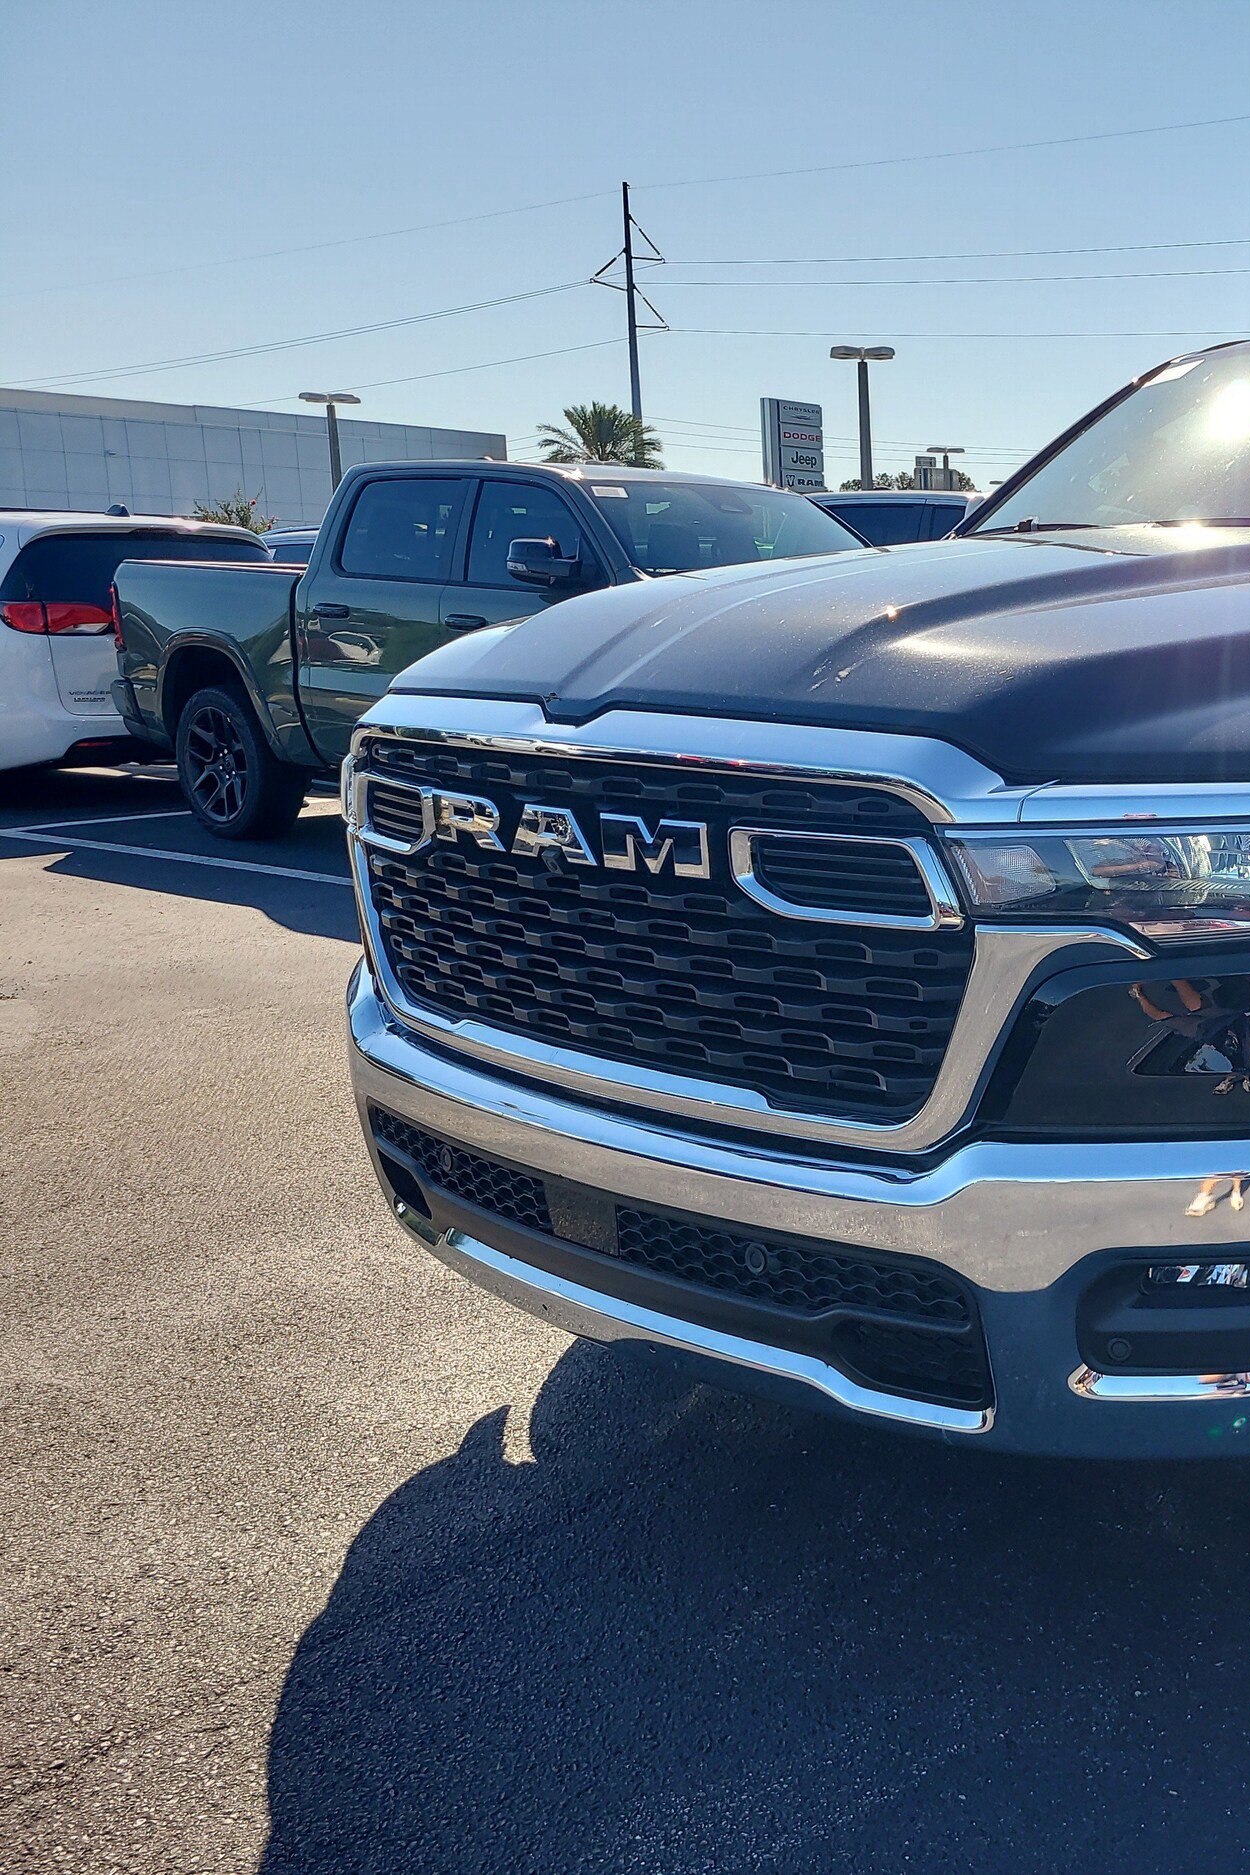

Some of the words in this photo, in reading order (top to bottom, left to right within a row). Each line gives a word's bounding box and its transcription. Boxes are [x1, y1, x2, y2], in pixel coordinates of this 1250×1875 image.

[783, 405, 820, 415] CHRYSLER
[783, 431, 822, 442] DODGE
[791, 450, 817, 468] Jeep
[797, 478, 824, 487] RAM
[433, 787, 711, 879] RAM
